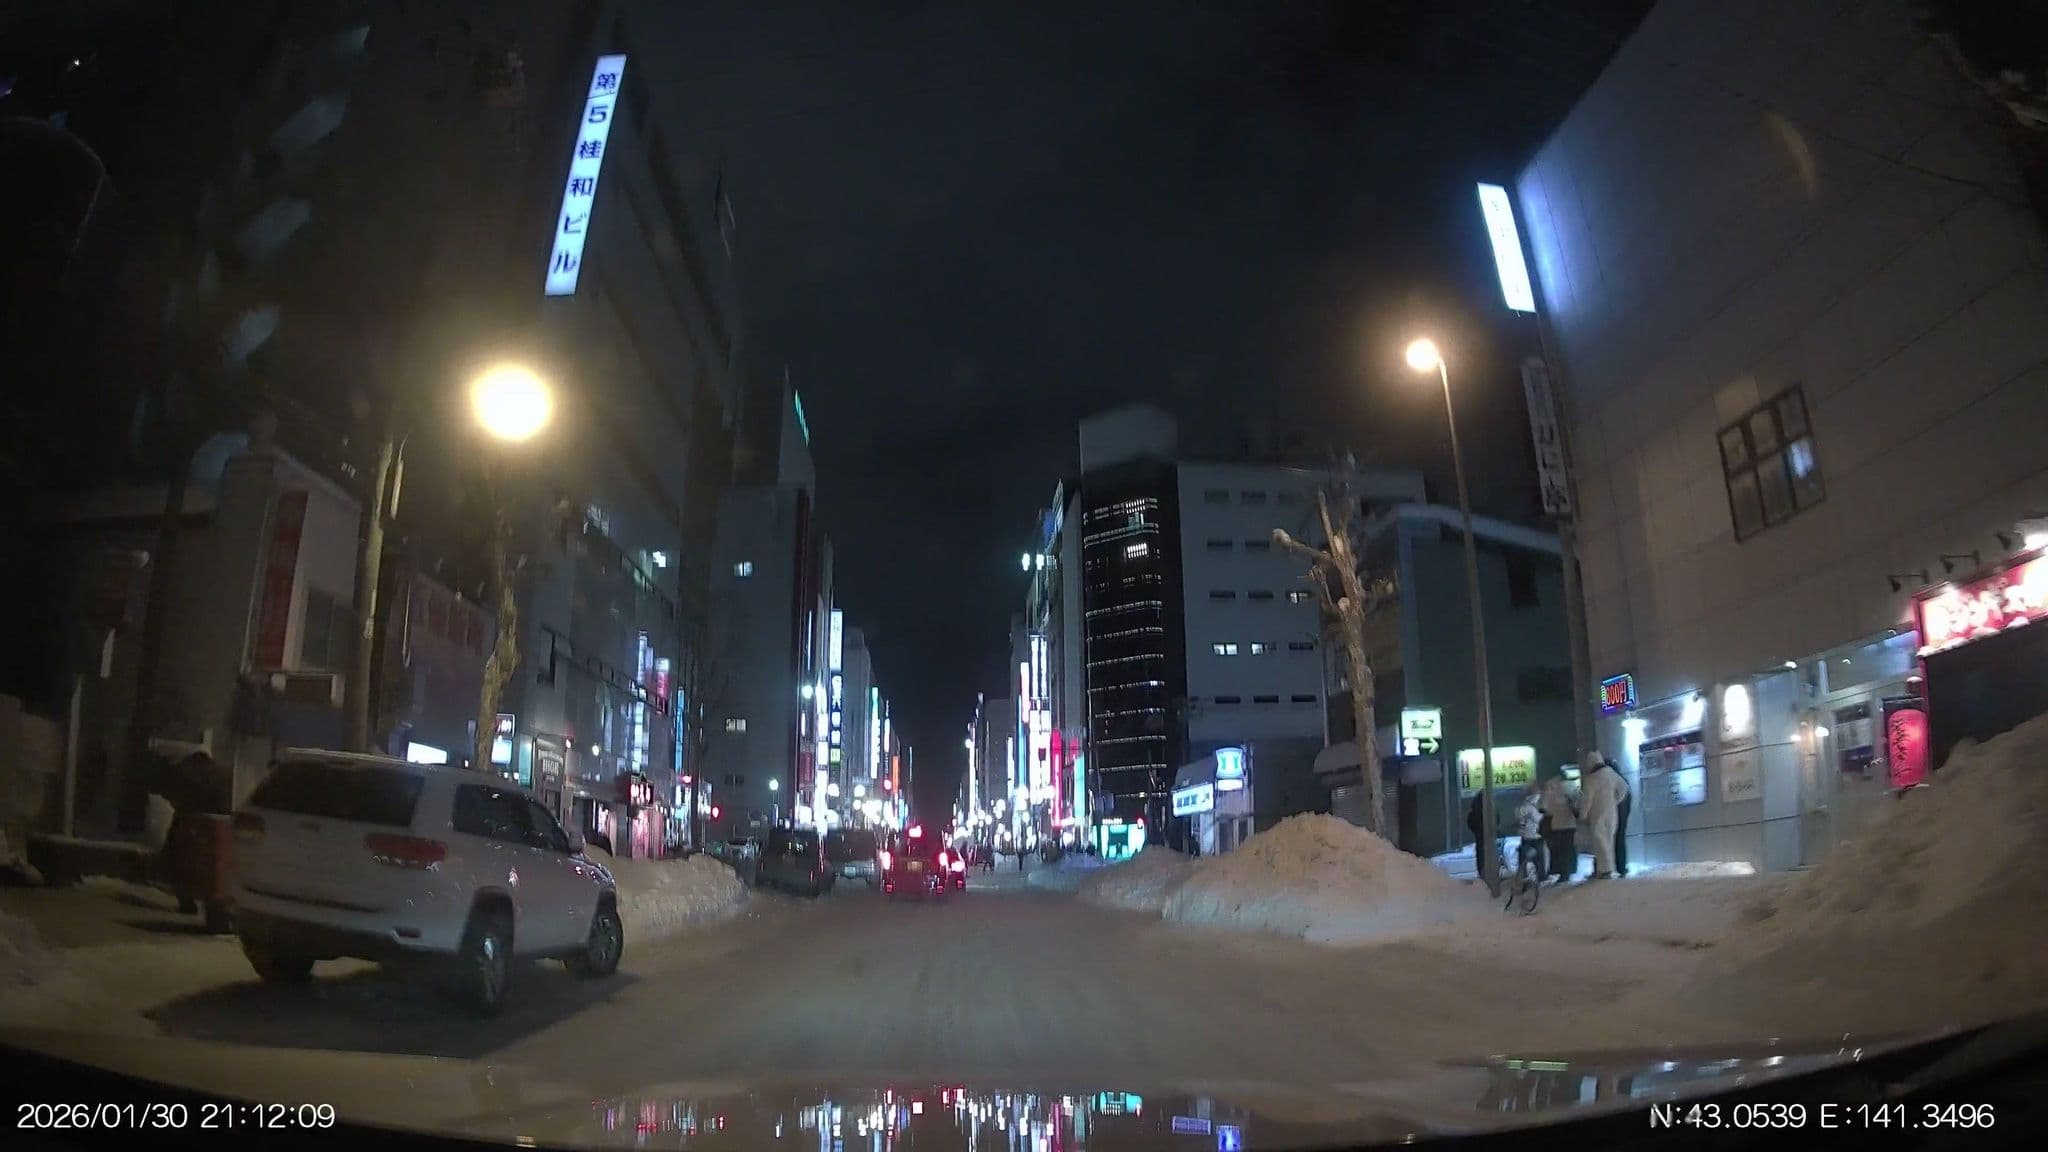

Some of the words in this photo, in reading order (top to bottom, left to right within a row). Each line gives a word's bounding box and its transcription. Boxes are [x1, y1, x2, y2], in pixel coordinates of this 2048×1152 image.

[553, 72, 619, 273] 第5桂和ビル
